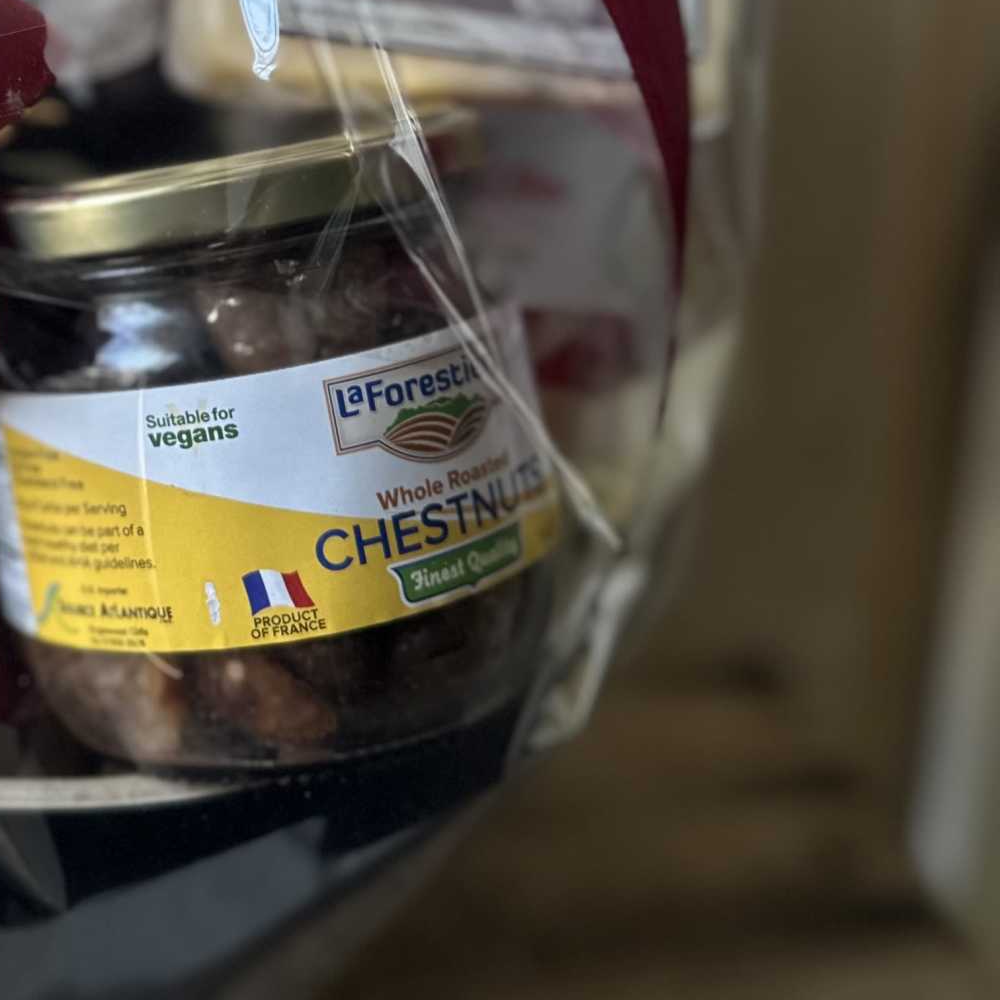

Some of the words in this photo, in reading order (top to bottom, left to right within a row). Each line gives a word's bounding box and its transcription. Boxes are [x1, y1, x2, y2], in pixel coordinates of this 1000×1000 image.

[146, 409, 210, 429] Suitable
[212, 407, 235, 421] for
[148, 423, 239, 449] vegans
[376, 478, 444, 511] Whole
[84, 502, 127, 517] Serving
[122, 523, 135, 537] of
[136, 526, 145, 537] a
[409, 557, 465, 591] Finest
[251, 627, 269, 639] OF
[272, 618, 327, 637] FRANCE
[253, 608, 318, 628] PRODUCT
